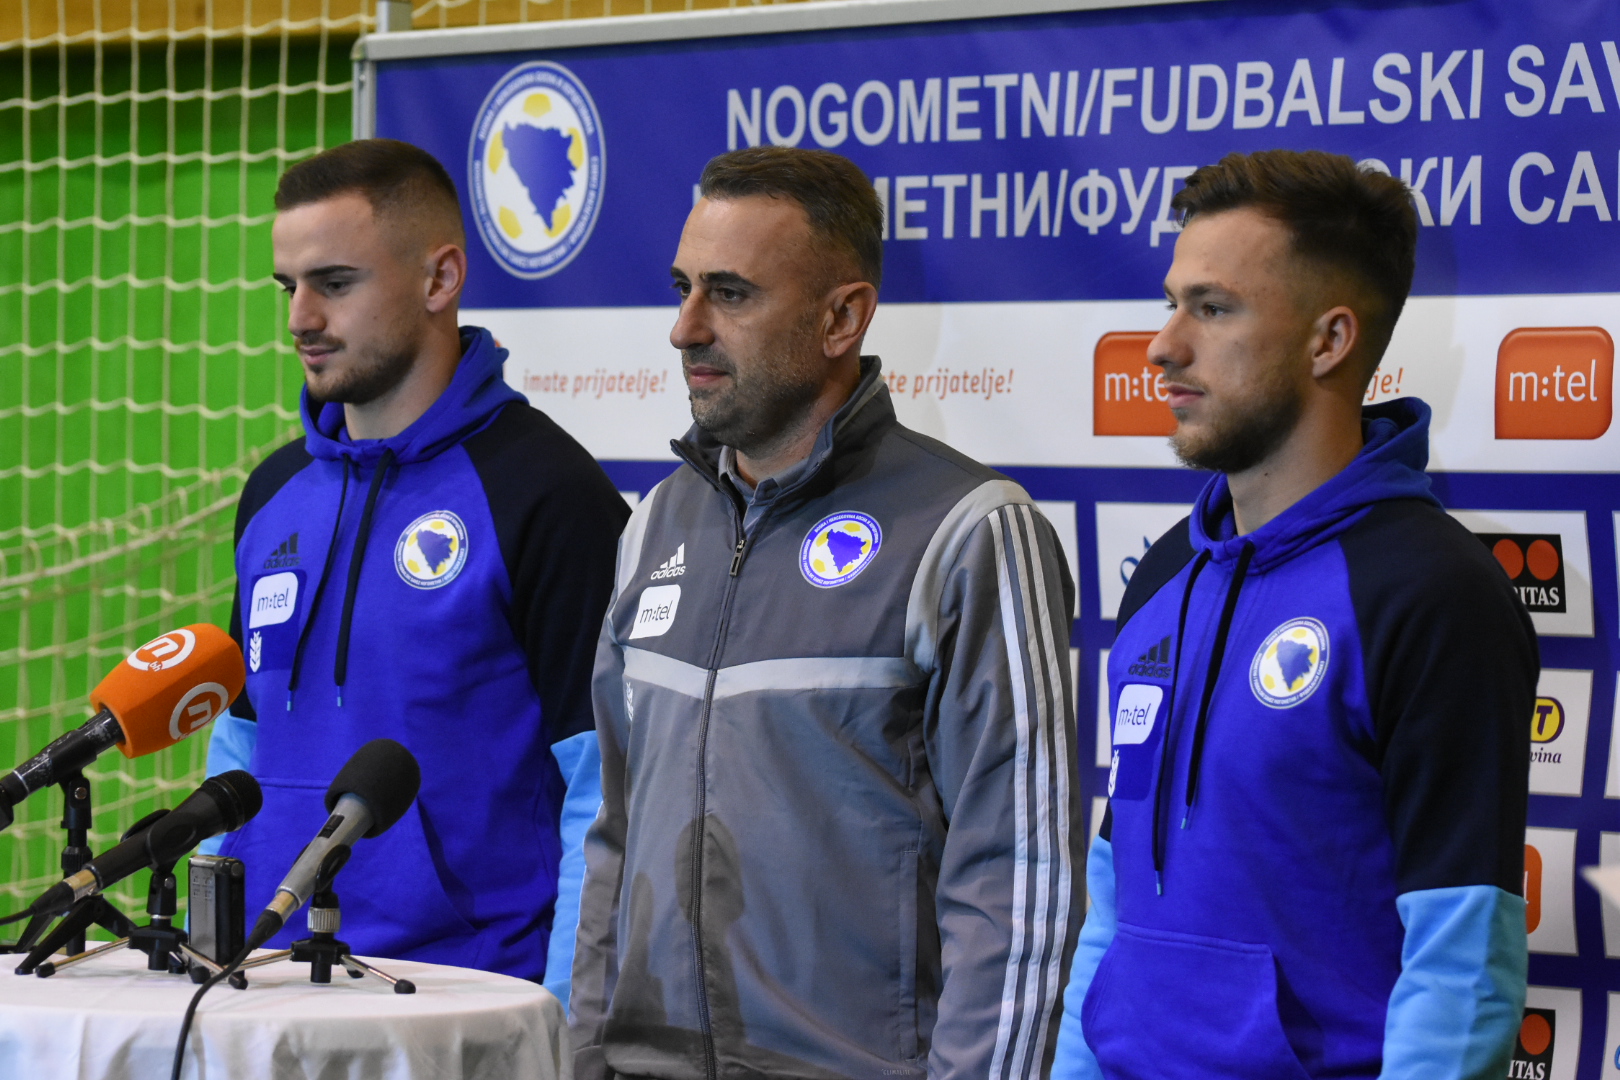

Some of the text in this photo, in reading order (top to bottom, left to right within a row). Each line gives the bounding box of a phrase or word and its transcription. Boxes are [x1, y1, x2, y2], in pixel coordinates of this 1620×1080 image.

[726, 49, 1484, 150] NOGOMETNI/FUDBALSKI
[1508, 150, 1620, 225] СА
[523, 368, 668, 399] imate prijatelje!
[912, 368, 1014, 400] prijatelje!
[1105, 366, 1170, 402] m:te
[1508, 359, 1598, 402] m:tel
[650, 564, 686, 580] adidas
[257, 587, 289, 612] m:tel
[639, 600, 672, 624] m:tel
[1128, 661, 1172, 679] adidas
[1118, 703, 1151, 726] m:tel
